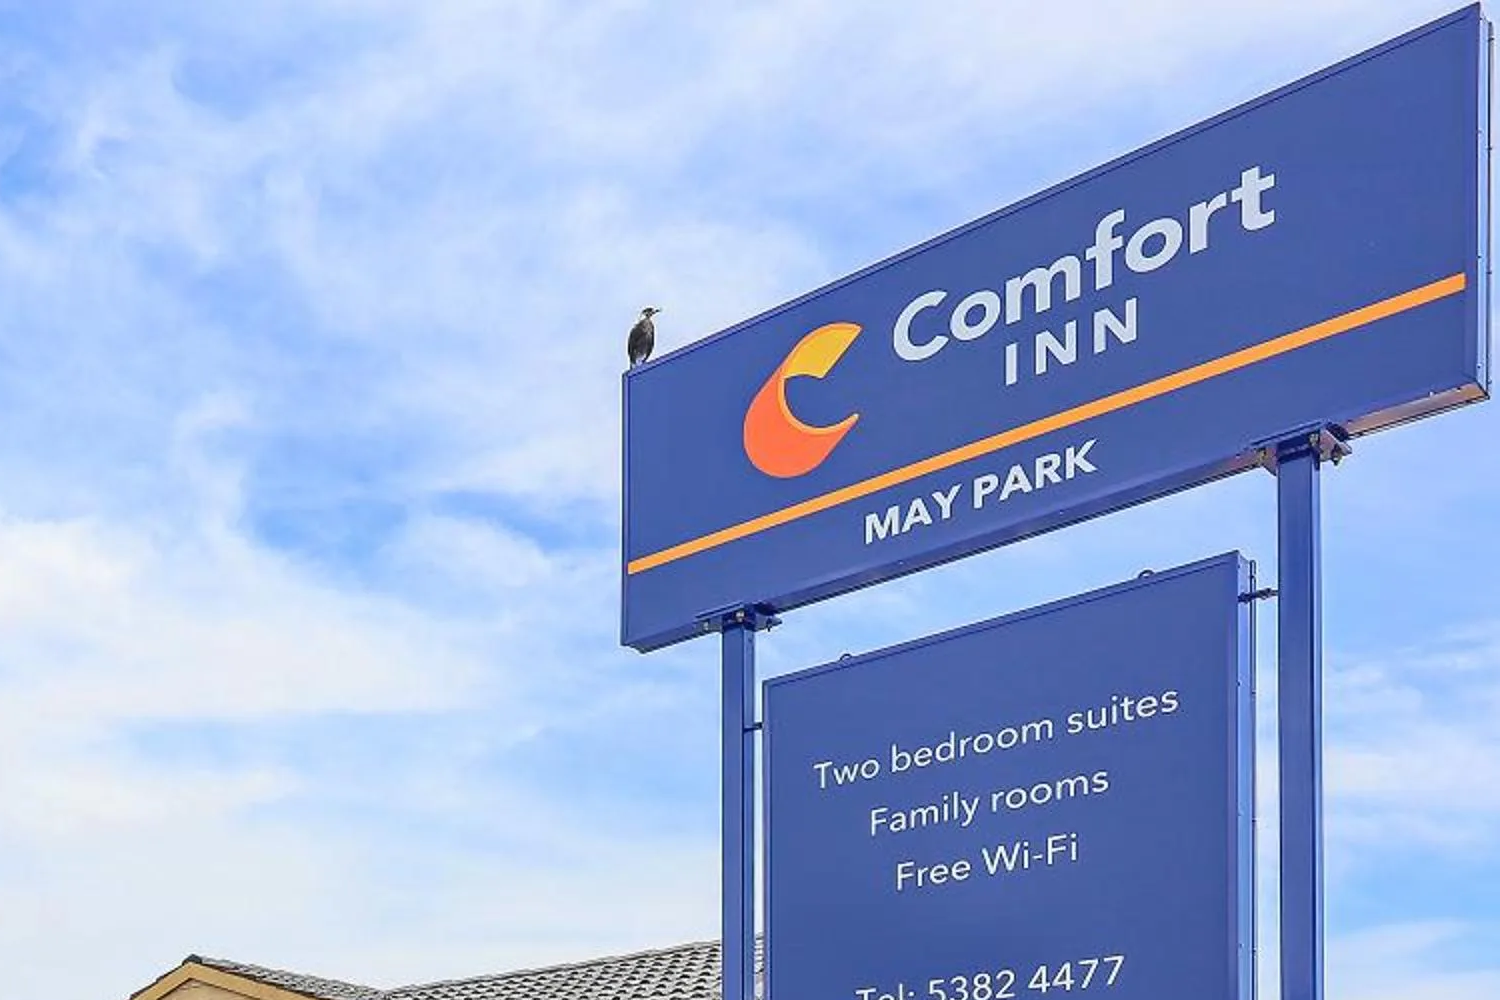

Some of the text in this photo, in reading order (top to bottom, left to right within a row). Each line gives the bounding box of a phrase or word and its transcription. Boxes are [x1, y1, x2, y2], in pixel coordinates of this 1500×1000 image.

[893, 166, 1276, 361] Comfort
[1004, 297, 1138, 386] INN
[863, 438, 1098, 545] MAY PARK
[813, 687, 1180, 790] Two bedroom suites
[870, 770, 1110, 837] Family rooms
[896, 833, 1078, 892] Free Wi-Fi
[1027, 954, 1126, 994] 4477
